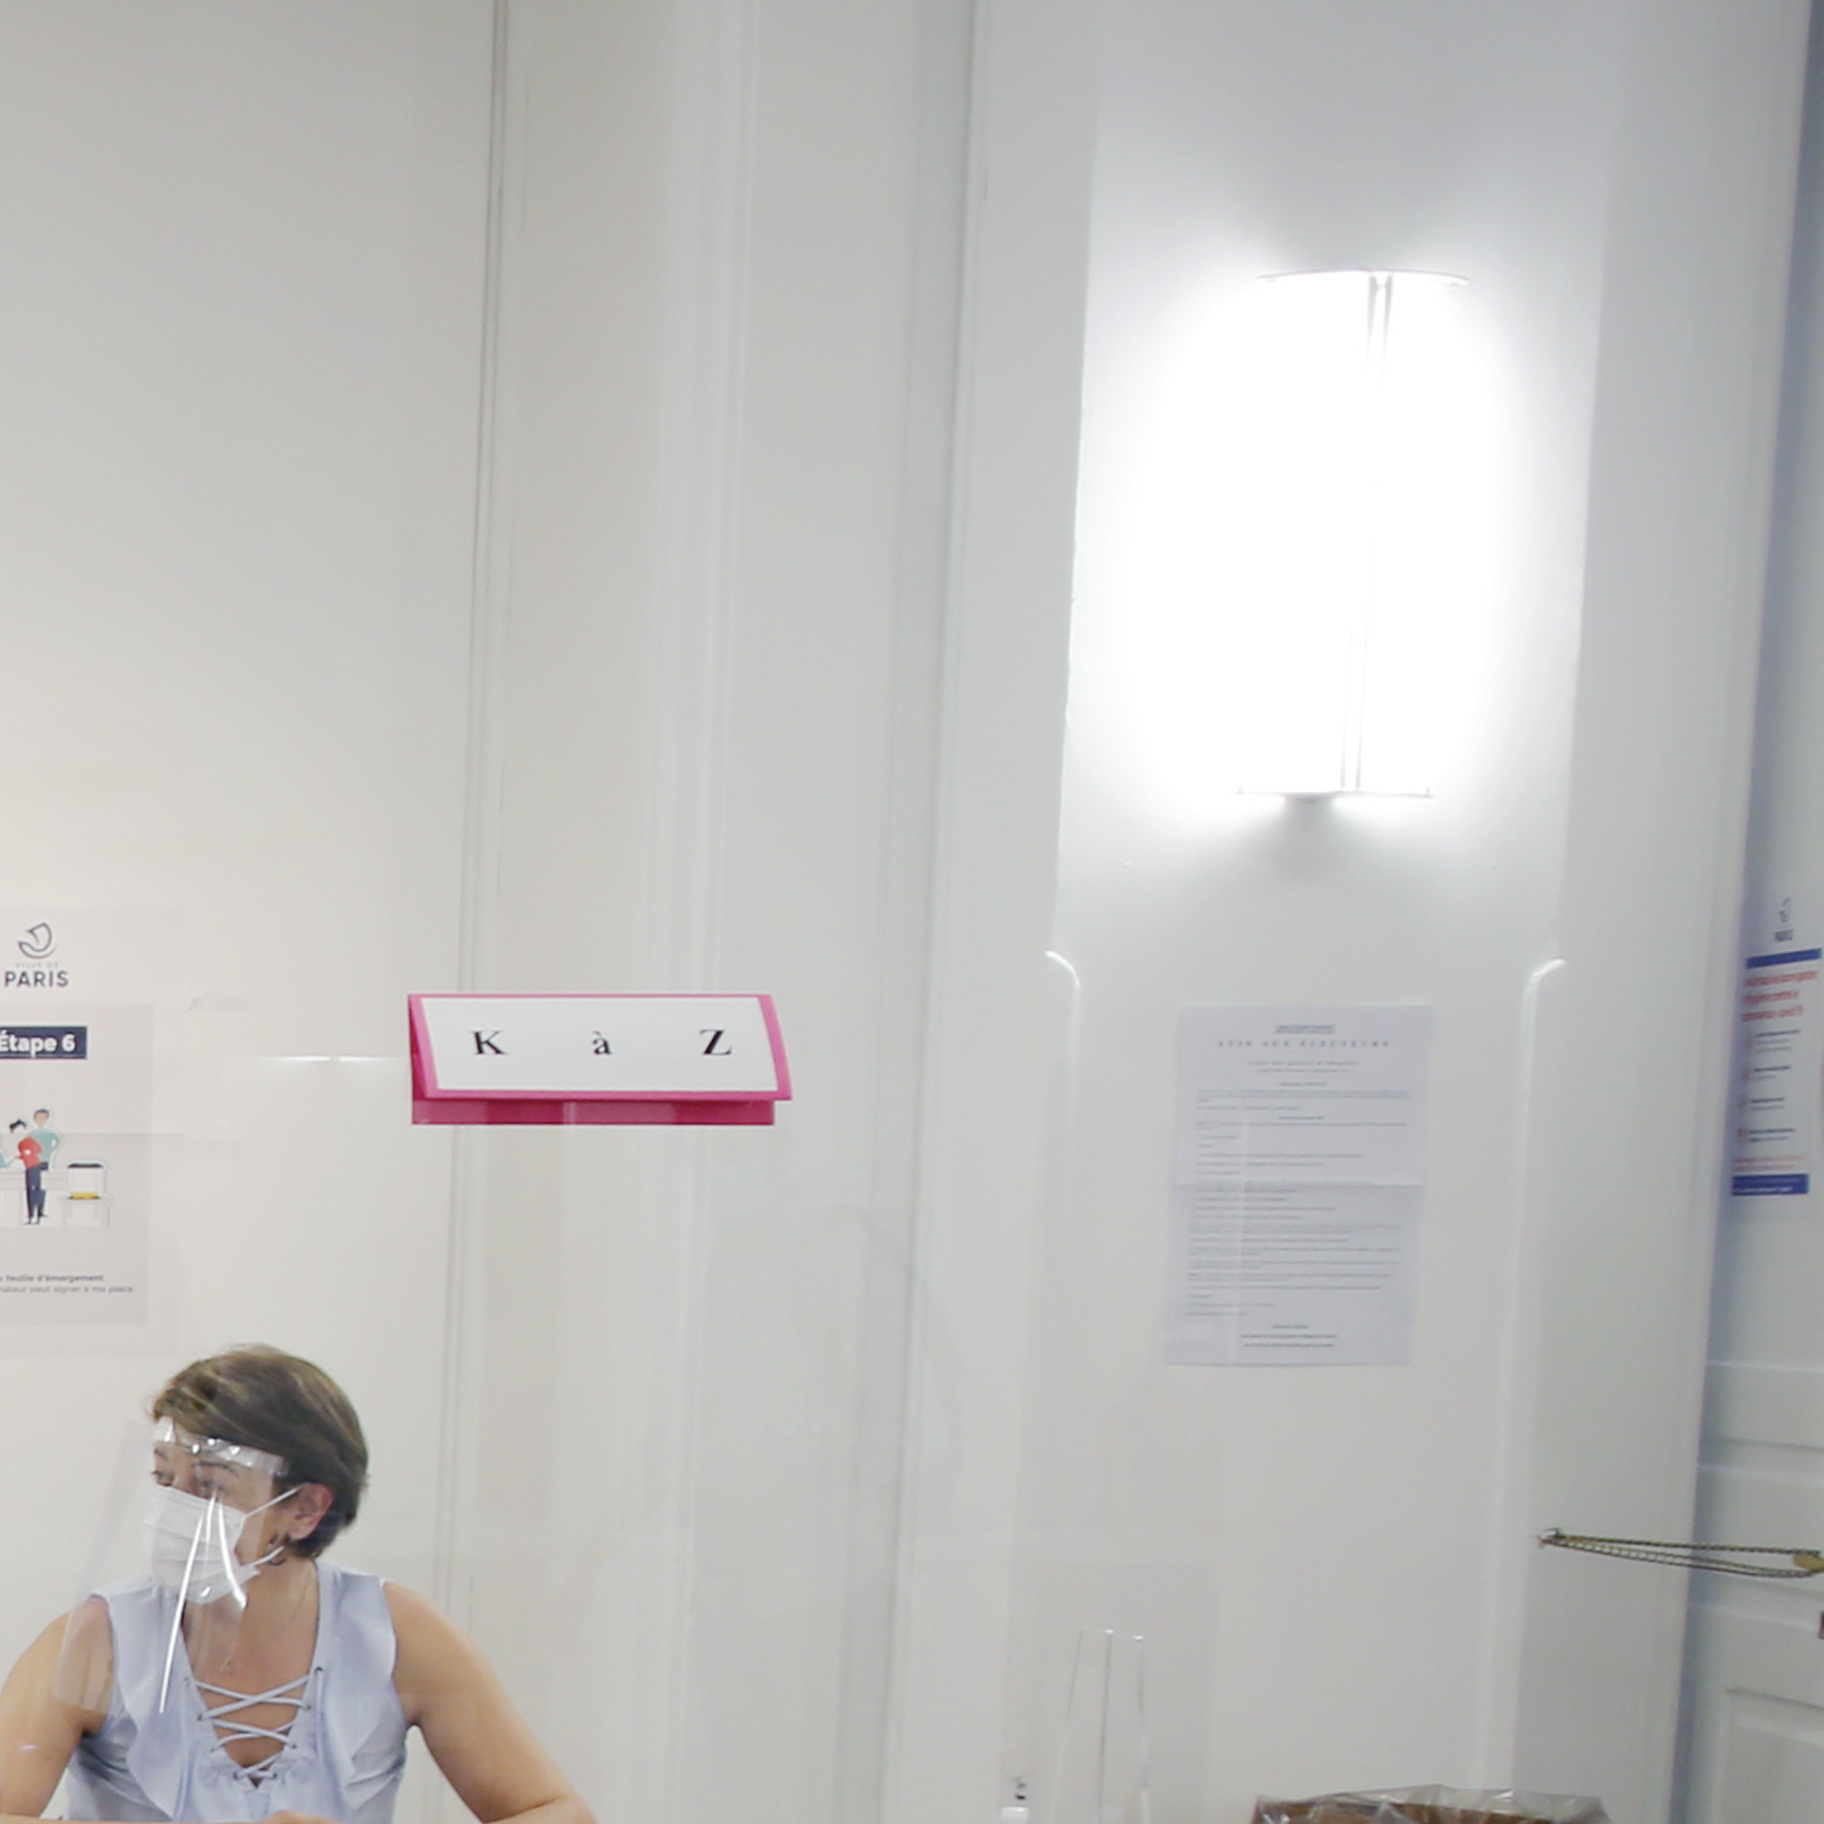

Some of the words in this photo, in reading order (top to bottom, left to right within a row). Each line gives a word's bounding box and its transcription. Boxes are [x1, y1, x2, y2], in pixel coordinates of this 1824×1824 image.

[5, 971, 69, 987] PARIS
[62, 1034, 76, 1052] 6
[470, 1029, 507, 1056] K
[591, 1030, 613, 1056] à
[699, 1028, 732, 1056] Z
